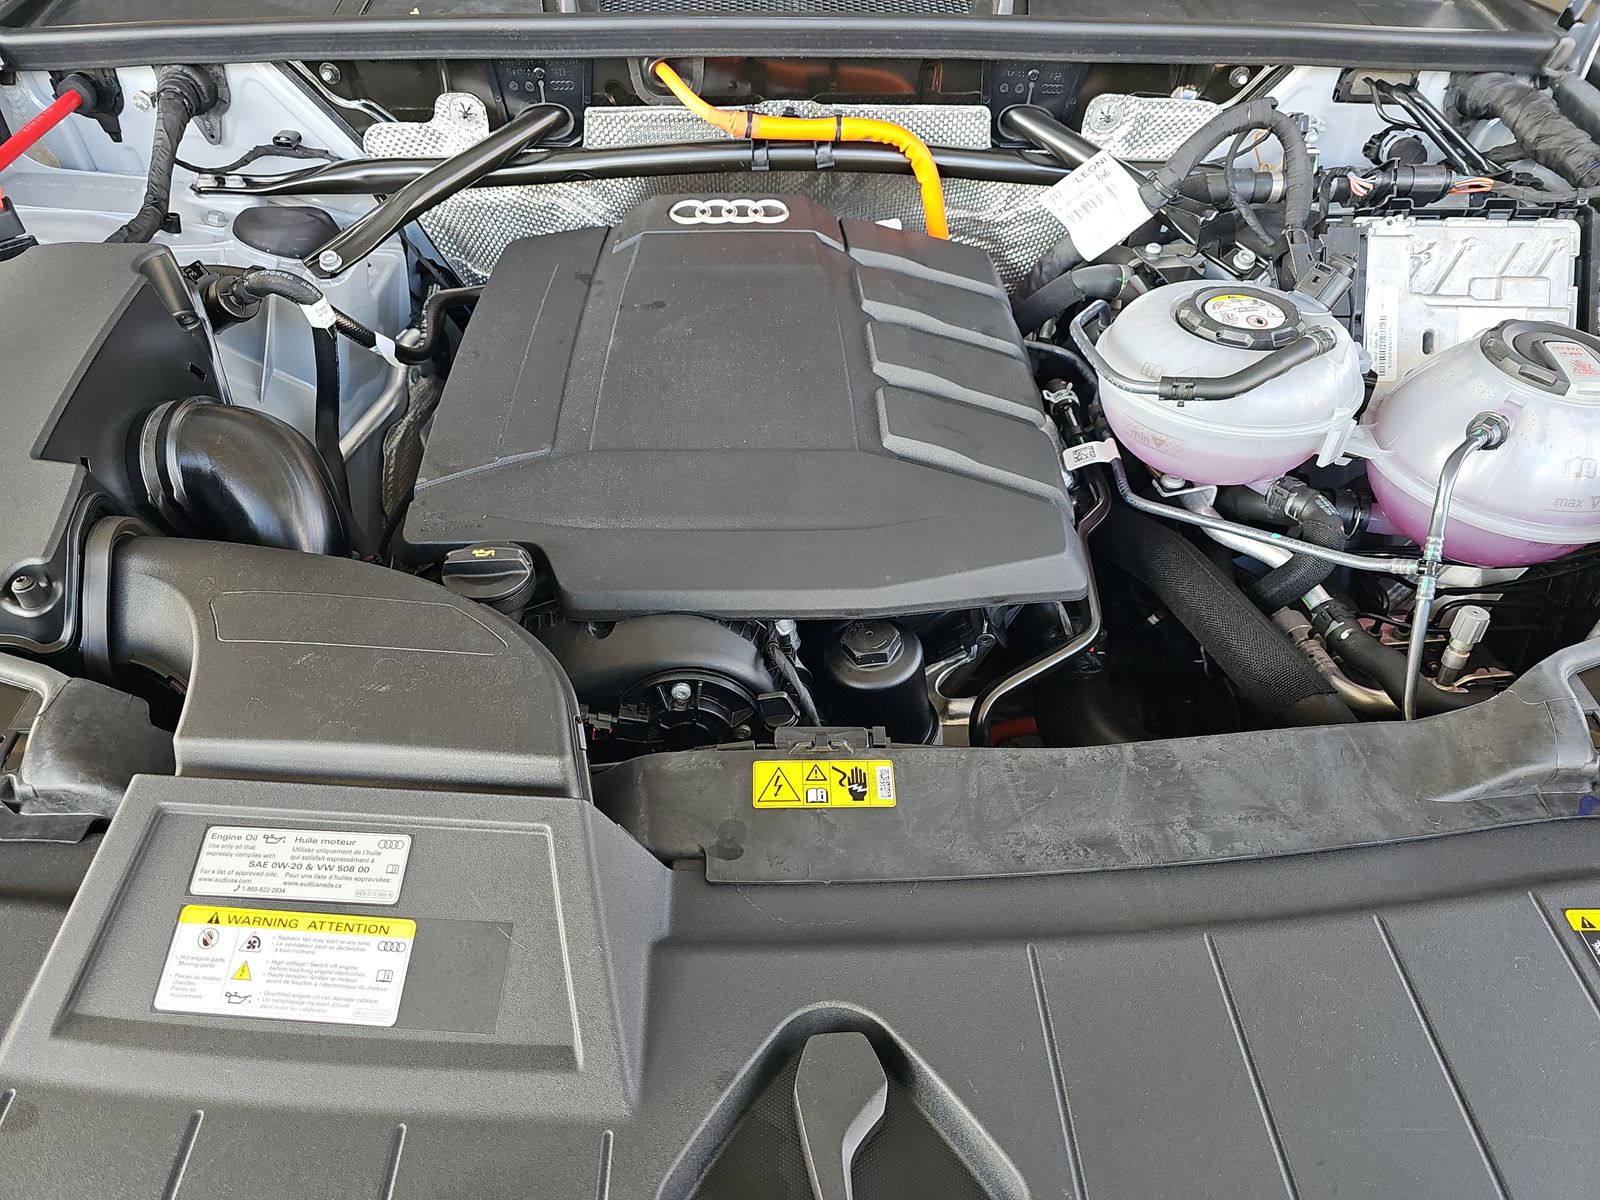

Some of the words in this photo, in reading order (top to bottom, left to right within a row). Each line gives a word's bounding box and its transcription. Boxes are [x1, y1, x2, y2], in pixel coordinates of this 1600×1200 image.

[1074, 156, 1108, 183] LEONI
[1131, 430, 1150, 445] min
[1554, 497, 1584, 508] max
[211, 833, 242, 841] Engine
[294, 836, 318, 845] Huile
[320, 838, 356, 846] moteur
[315, 847, 352, 856] uniquement
[248, 860, 269, 869] SAE
[271, 861, 302, 871] 0W-20
[337, 865, 355, 873] 508
[227, 915, 299, 929] WARNING
[307, 920, 390, 935] ATTENTION
[284, 941, 313, 949] ventilateur
